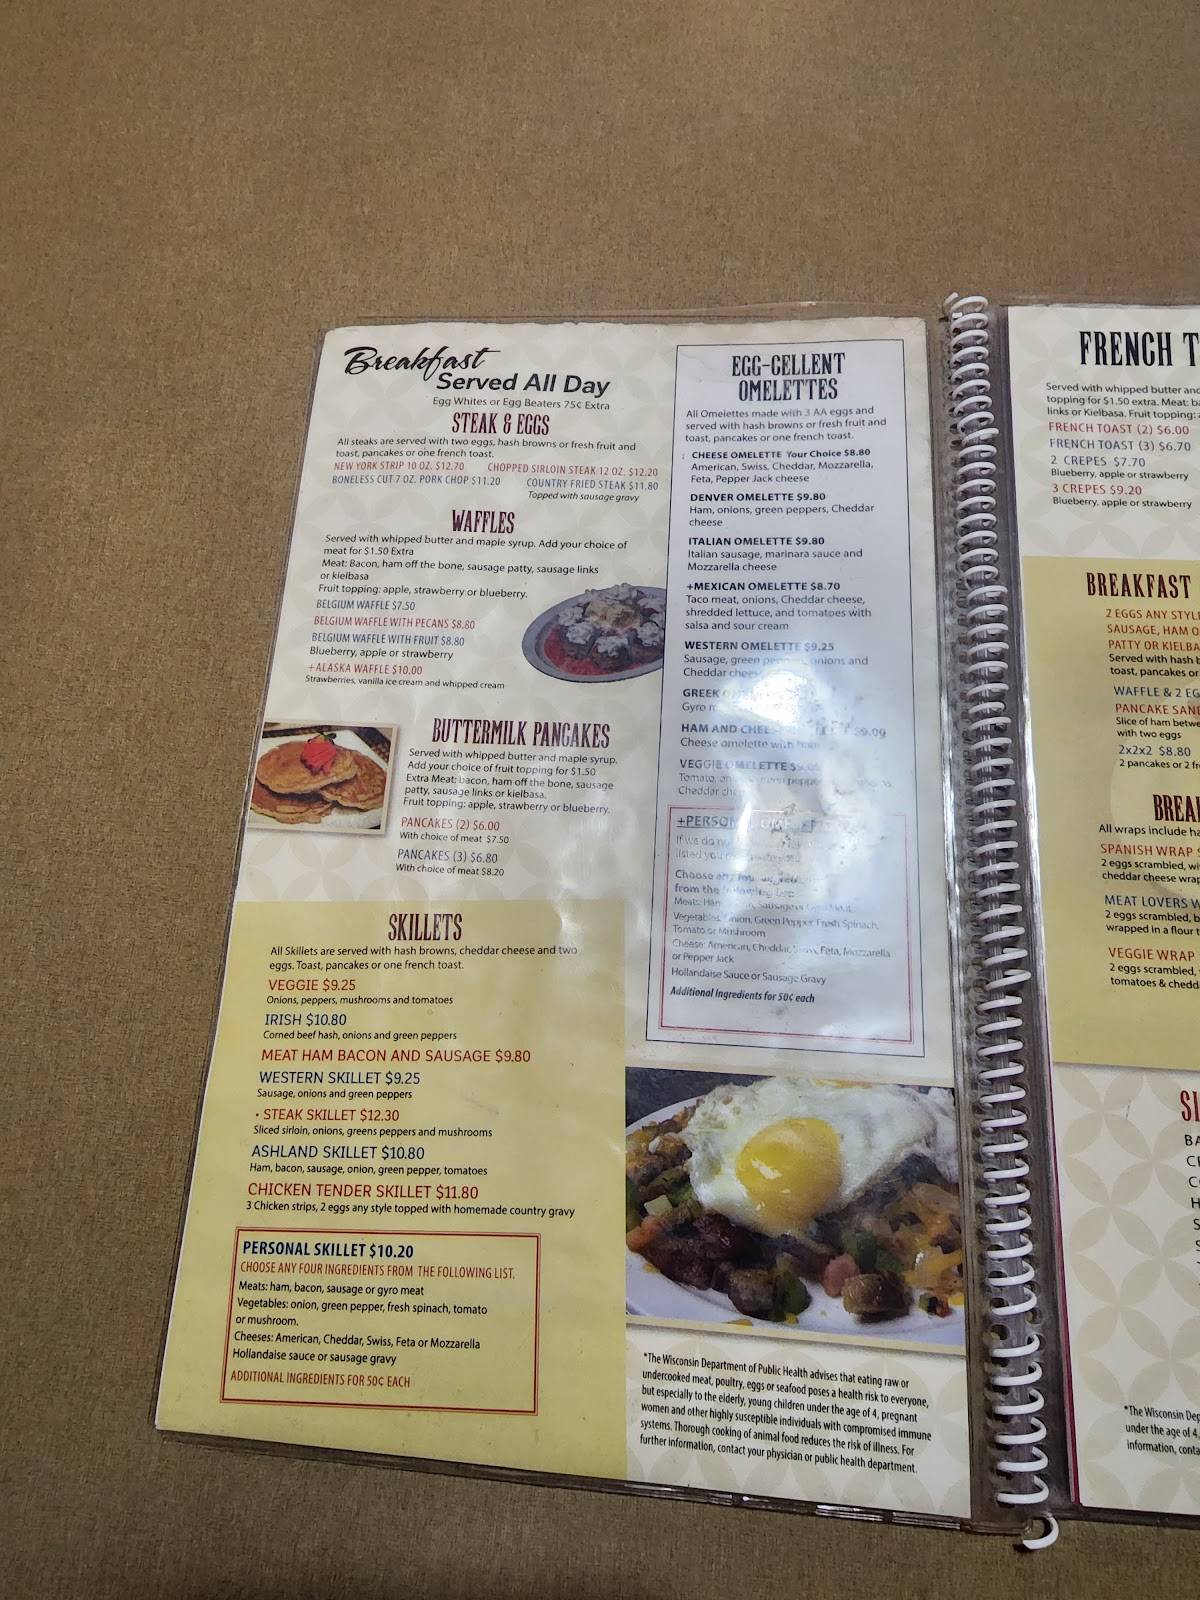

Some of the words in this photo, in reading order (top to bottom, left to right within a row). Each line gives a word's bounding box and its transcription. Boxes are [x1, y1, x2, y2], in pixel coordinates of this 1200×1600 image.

[1080, 331, 1172, 366] FRENCH
[344, 345, 501, 381] Breakfast
[732, 352, 846, 377] EGG-CELLENT
[436, 373, 518, 391] Served
[523, 374, 556, 392] All
[563, 375, 611, 398] Day
[739, 378, 838, 402] OMELETTES
[432, 396, 451, 407] Egg
[453, 396, 487, 405] Whites
[502, 397, 521, 408] Egg
[524, 398, 561, 408] Beaters
[563, 400, 581, 409] 75¢
[584, 400, 610, 410] Extra
[452, 412, 497, 434] STEAK
[504, 413, 511, 434] &
[517, 414, 550, 436] EGGS
[1048, 421, 1093, 432] FRENCH
[1096, 423, 1132, 434] TOAST
[1136, 423, 1153, 435] (2)
[1156, 424, 1189, 435] $6.00
[691, 451, 728, 459] CHEESE
[730, 451, 781, 459] OMELETTE
[786, 450, 808, 458] Your
[809, 449, 841, 458] Choice
[844, 448, 871, 456] $8.80
[333, 461, 353, 471] NEW
[355, 461, 377, 471] YORK
[379, 460, 404, 470] STRIP
[407, 461, 417, 470] 10
[418, 461, 432, 471] OZ.
[435, 461, 464, 471] $12.70
[1050, 455, 1057, 464] 2
[1063, 455, 1107, 466] CREPES
[1113, 456, 1145, 467] $7.70
[487, 462, 529, 473] CHOPPED
[531, 464, 566, 474] SIRLOIN
[568, 465, 596, 475] STEAK
[599, 466, 609, 476] 12
[611, 467, 625, 476] OZ.
[628, 467, 658, 477] $12.20
[1050, 468, 1097, 479] Blueberry,
[1098, 470, 1125, 479] apple
[1139, 471, 1189, 481] strawberry
[528, 490, 559, 500] Topped
[559, 492, 578, 500] with
[580, 494, 614, 502] sausage
[615, 494, 640, 503] gravy
[690, 493, 733, 502] DENVER
[736, 492, 794, 501] OMELETTE
[796, 492, 826, 502] $9.80
[452, 510, 515, 533] WAFFLES
[688, 537, 731, 546] ITALIAN
[734, 536, 792, 545] OMELETTE
[795, 536, 825, 546] $9.80
[687, 549, 718, 558] Italian
[720, 551, 762, 560] sausage,
[765, 549, 810, 558] marinara
[812, 550, 841, 558] sauce
[843, 547, 863, 558] and
[687, 561, 740, 571] Mozzarella
[742, 562, 777, 571] cheese
[686, 582, 745, 591] +MEXICAN
[747, 582, 807, 591] OMELETTE
[810, 581, 840, 591] $8.70
[1087, 572, 1190, 598] BREAKFAST
[316, 599, 354, 609] BELGIUM
[356, 600, 390, 610] WAFFLE
[392, 600, 416, 611] $7.50
[353, 663, 389, 674] WAFFLE
[392, 664, 422, 675] $10.00
[358, 677, 384, 685] vanilla
[385, 678, 397, 686] ice
[442, 679, 478, 689] whipped
[1113, 685, 1160, 696] WAFFLE
[1163, 687, 1172, 697] &
[1175, 688, 1181, 697] 2
[432, 718, 527, 745] BUTTERMILK
[532, 722, 610, 748] PANCAKES
[1116, 728, 1137, 737] with
[1139, 730, 1157, 738] two
[1158, 731, 1182, 741] eggs
[1118, 744, 1152, 755] 2x2x2
[1158, 745, 1191, 756] $8.80
[401, 816, 452, 828] PANCAKES
[455, 818, 470, 831] (2)
[472, 819, 500, 831] $6.00
[399, 831, 419, 839] With
[420, 831, 448, 841] choice
[449, 833, 460, 842] of
[460, 835, 482, 843] meat
[486, 834, 509, 845] $7.50
[1104, 894, 1137, 906] MEAT
[1142, 896, 1188, 908] LOVERS
[388, 913, 462, 940] SKILLETS
[268, 979, 319, 991] VEGGIE
[322, 978, 356, 992] $9.25
[266, 995, 299, 1005] Onions,
[300, 997, 337, 1006] peppers,
[339, 995, 391, 1004] mushrooms
[392, 995, 410, 1004] and
[411, 996, 453, 1004] tomatoes
[264, 1013, 302, 1026] IRISH
[305, 1012, 347, 1027] $10.80
[261, 1048, 298, 1061] MEAT
[301, 1049, 333, 1061] HAM
[337, 1049, 386, 1062] BACON
[390, 1049, 420, 1062] AND
[425, 1049, 491, 1062] SAUSAGE
[495, 1048, 530, 1064] $9.80
[259, 1071, 323, 1084] WESTERN
[327, 1071, 381, 1084] SKILLET
[385, 1070, 420, 1086] $9.25
[263, 1108, 303, 1120] STEAK
[306, 1108, 357, 1121] SKILLET
[359, 1108, 399, 1122] $12.30
[251, 1144, 318, 1158] ASHLAND
[323, 1145, 378, 1159] SKILLET
[381, 1145, 424, 1160] $10.80
[249, 1162, 273, 1173] Ham,
[274, 1162, 304, 1174] bacon,
[306, 1165, 345, 1176] sausage,
[346, 1164, 376, 1175] onion,
[377, 1166, 404, 1176] green
[406, 1167, 442, 1177] pepper,
[443, 1166, 488, 1176] tomatoes
[248, 1182, 311, 1196] CHICKEN
[315, 1183, 371, 1198] TENDER
[376, 1184, 432, 1198] SKILLET
[436, 1184, 478, 1200] $11.80
[242, 1240, 310, 1255] PERSONAL
[313, 1242, 366, 1257] SKILLET
[370, 1244, 414, 1258] $10.20
[234, 1330, 273, 1342] Cheeses:
[275, 1332, 321, 1345] American,
[323, 1333, 364, 1347] Cheddar,
[366, 1335, 393, 1348] Swiss,
[395, 1336, 415, 1347] Feta
[417, 1339, 428, 1348] or
[430, 1337, 480, 1349] Mozzarella
[662, 1353, 699, 1367] Wisconsin
[701, 1357, 746, 1372] Department
[748, 1362, 757, 1373] of
[758, 1363, 781, 1376] Public
[782, 1365, 808, 1378] Health
[809, 1368, 838, 1381] advises
[839, 1372, 855, 1383] that
[857, 1374, 882, 1388] eating
[884, 1378, 899, 1387] raw
[900, 1379, 909, 1388] or
[1125, 1422, 1149, 1434] under
[1150, 1423, 1164, 1435] the
[1165, 1427, 1180, 1439] age
[1182, 1426, 1190, 1438] of
